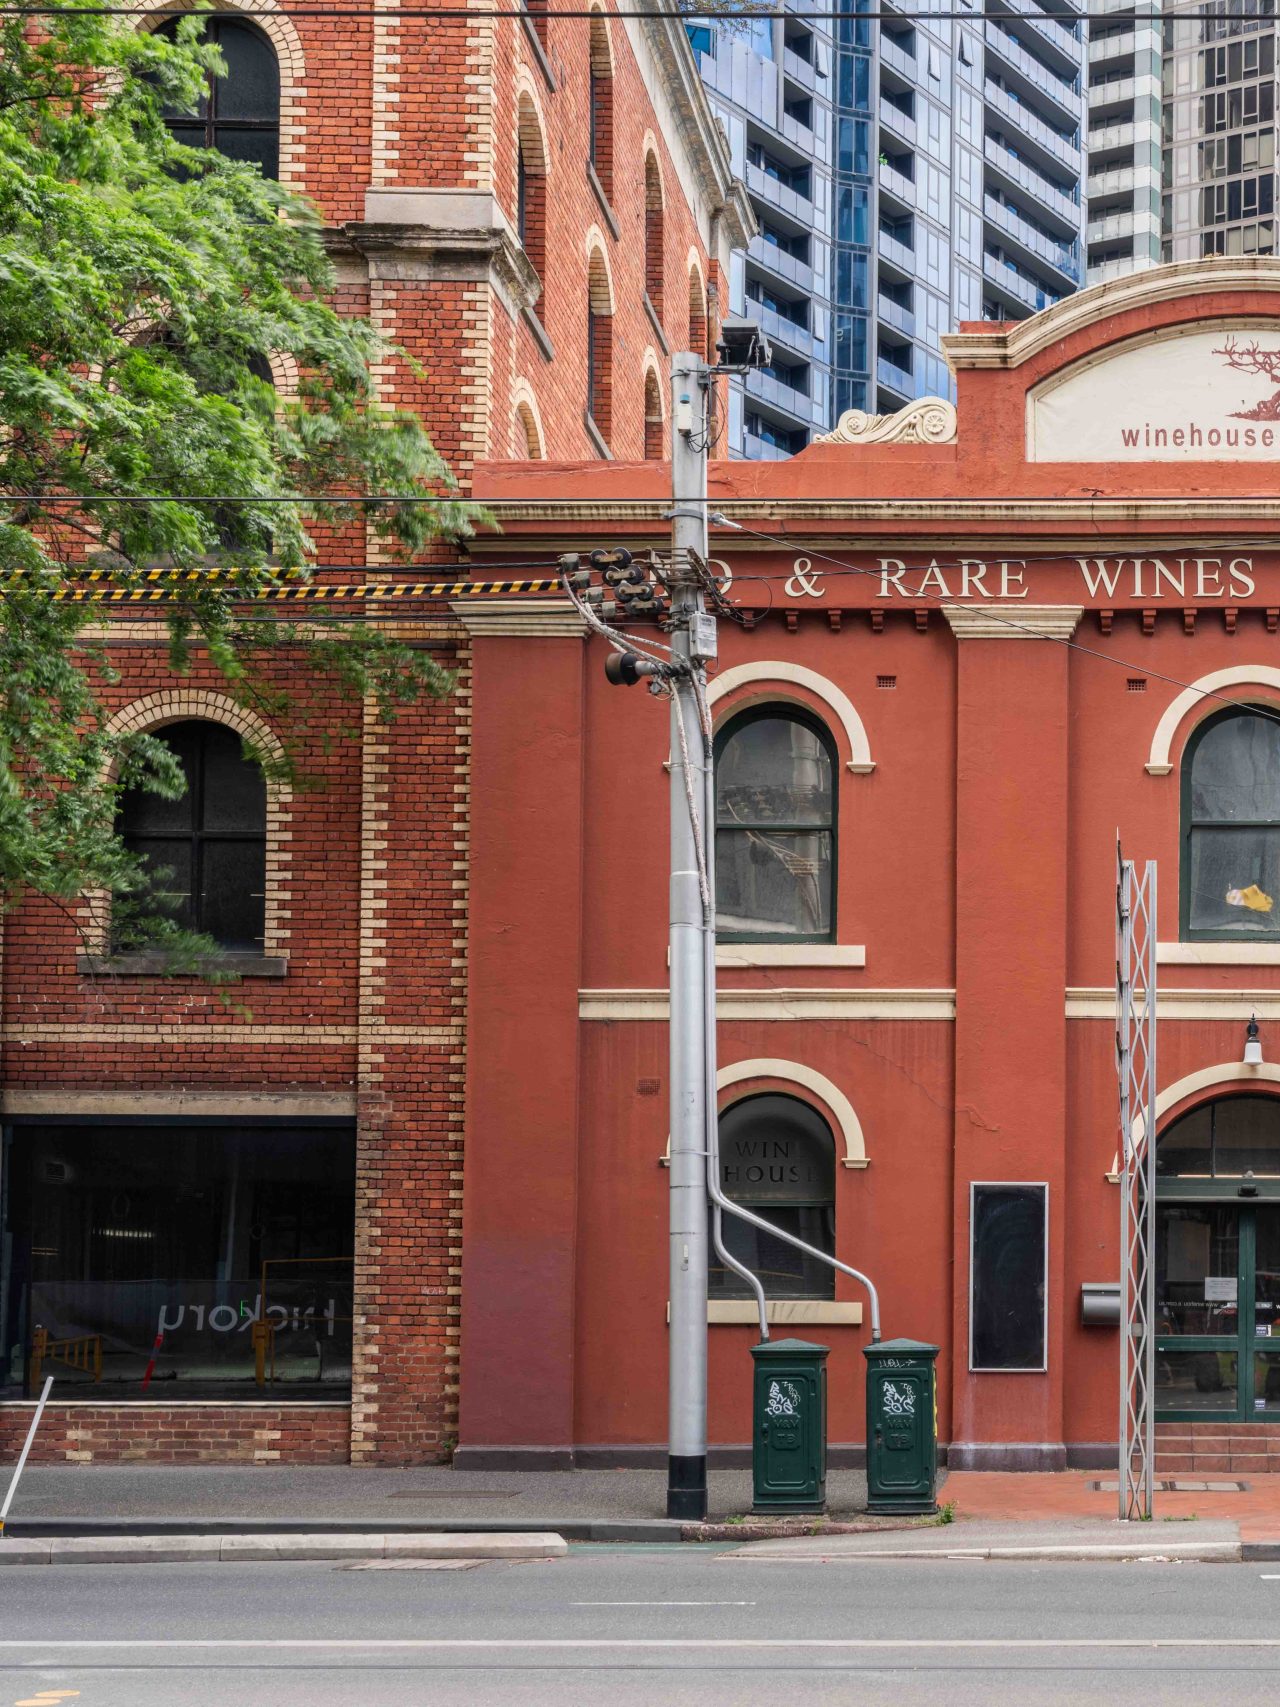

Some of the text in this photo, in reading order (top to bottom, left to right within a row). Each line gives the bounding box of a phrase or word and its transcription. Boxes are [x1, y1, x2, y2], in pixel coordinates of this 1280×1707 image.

[784, 557, 825, 598] &
[876, 557, 1029, 599] RARE
[1075, 557, 1256, 599] WINES
